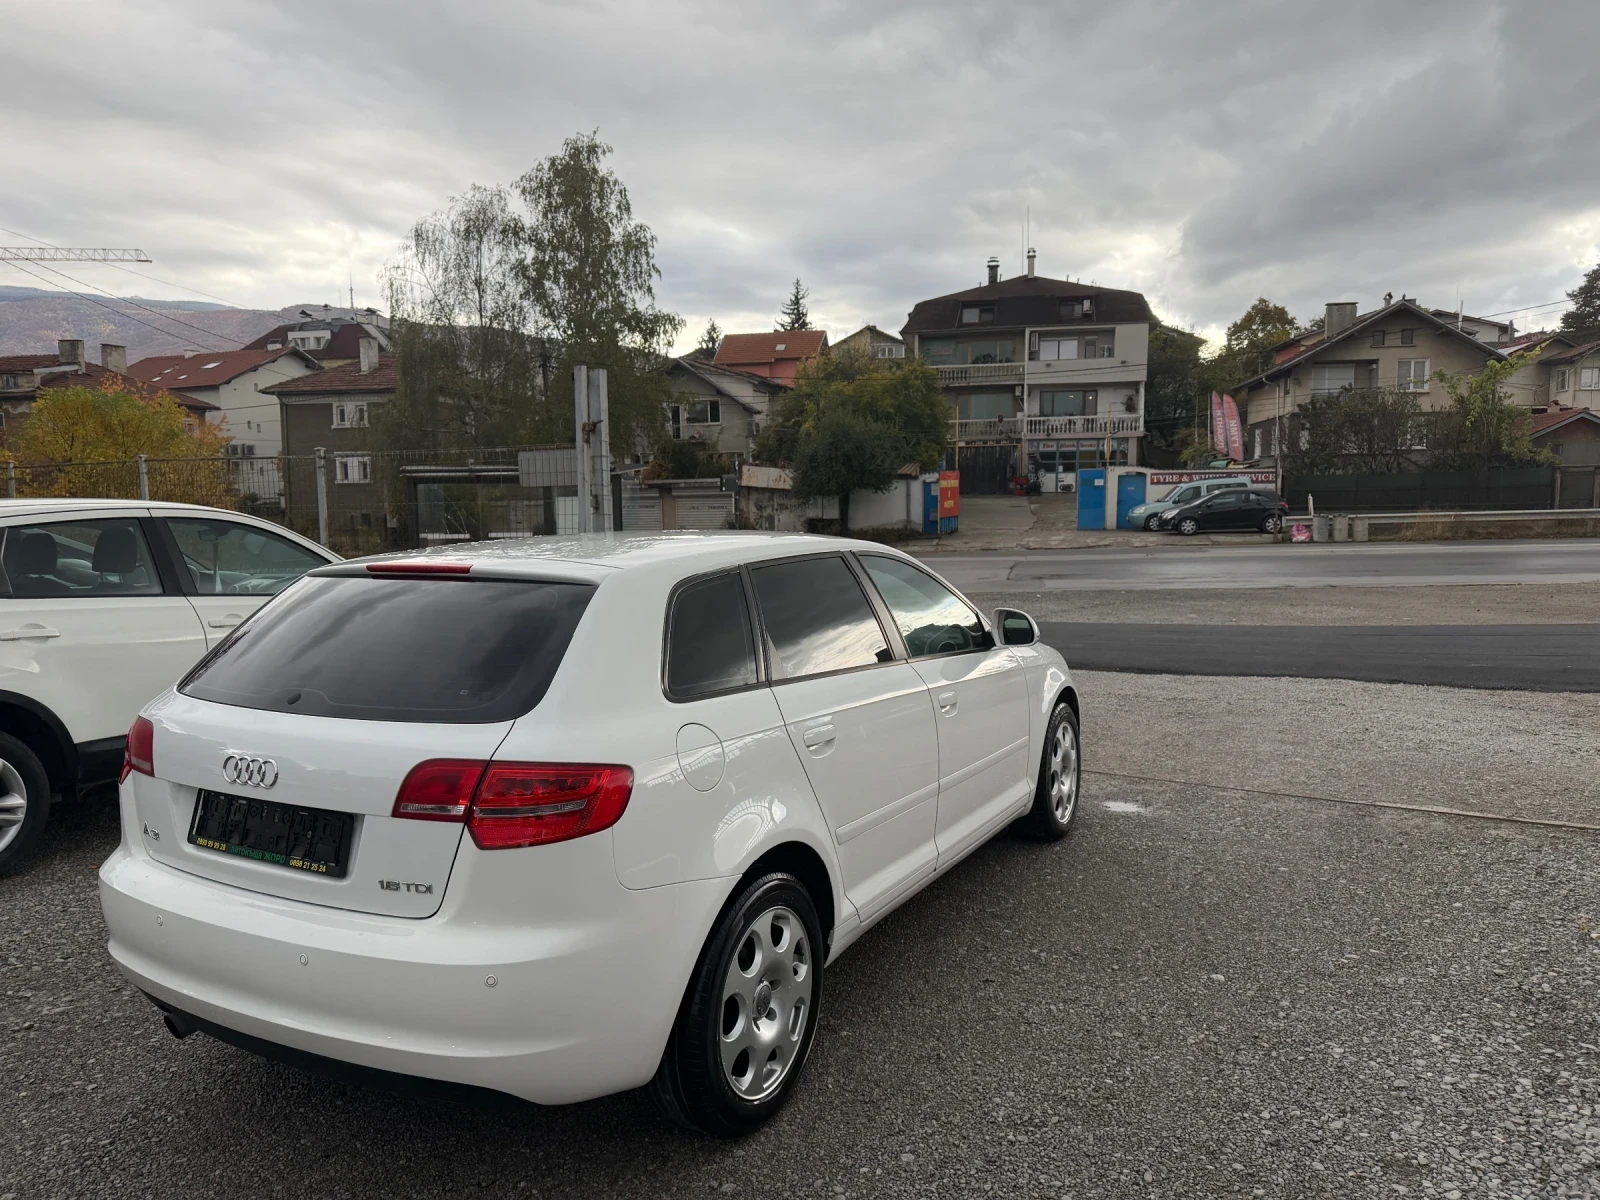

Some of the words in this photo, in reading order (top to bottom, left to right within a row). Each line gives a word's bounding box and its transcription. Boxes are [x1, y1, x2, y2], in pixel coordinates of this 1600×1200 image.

[1151, 474, 1180, 483] TYRE
[1181, 474, 1190, 483] &
[143, 820, 160, 841] A3
[263, 851, 286, 864] ЖОРО
[303, 861, 310, 870] 21
[311, 863, 318, 871] 25
[318, 864, 327, 873] 24
[401, 880, 434, 895] TDI
